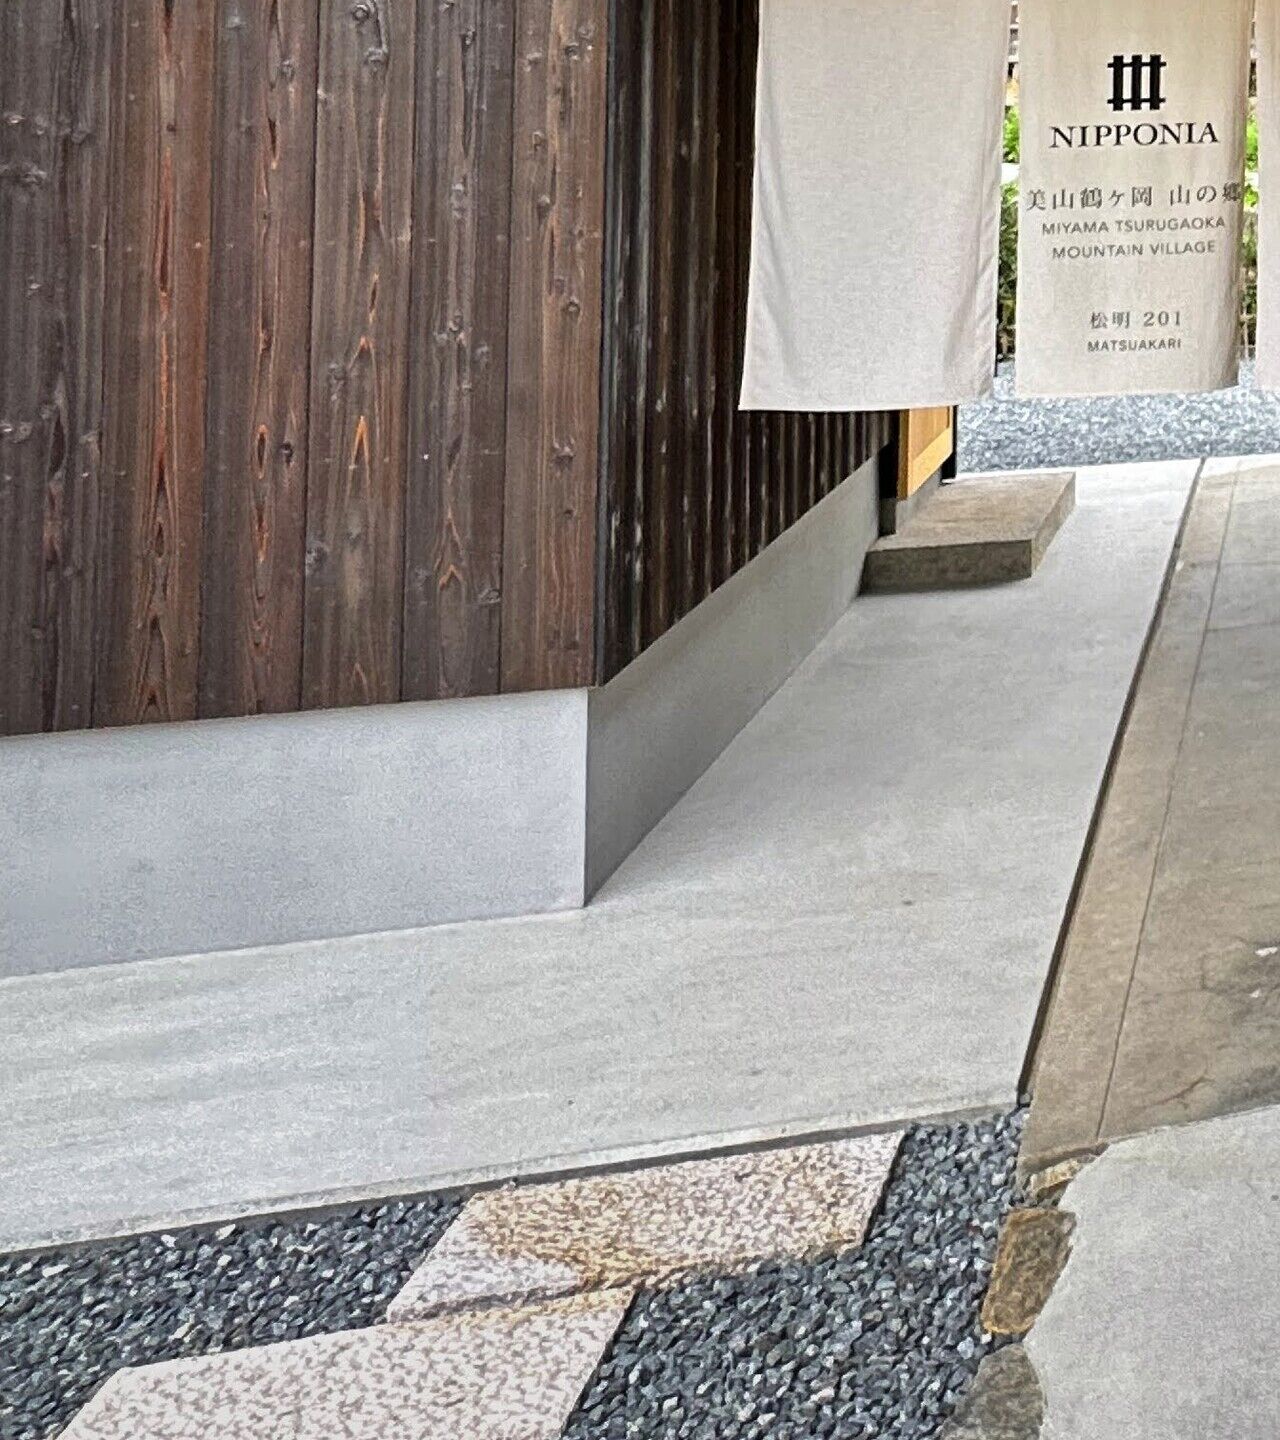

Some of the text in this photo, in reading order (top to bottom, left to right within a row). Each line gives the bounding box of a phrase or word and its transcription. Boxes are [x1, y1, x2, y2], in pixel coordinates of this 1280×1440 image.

[1050, 122, 1220, 148] NIPPONIA
[1042, 216, 1226, 236] MIYAMA TSURUGAOKA
[1052, 240, 1216, 260] MOUNTAIN VILLAGE
[1091, 311, 1181, 329] 松明 201
[1087, 337, 1181, 352] MATSUAKARI
